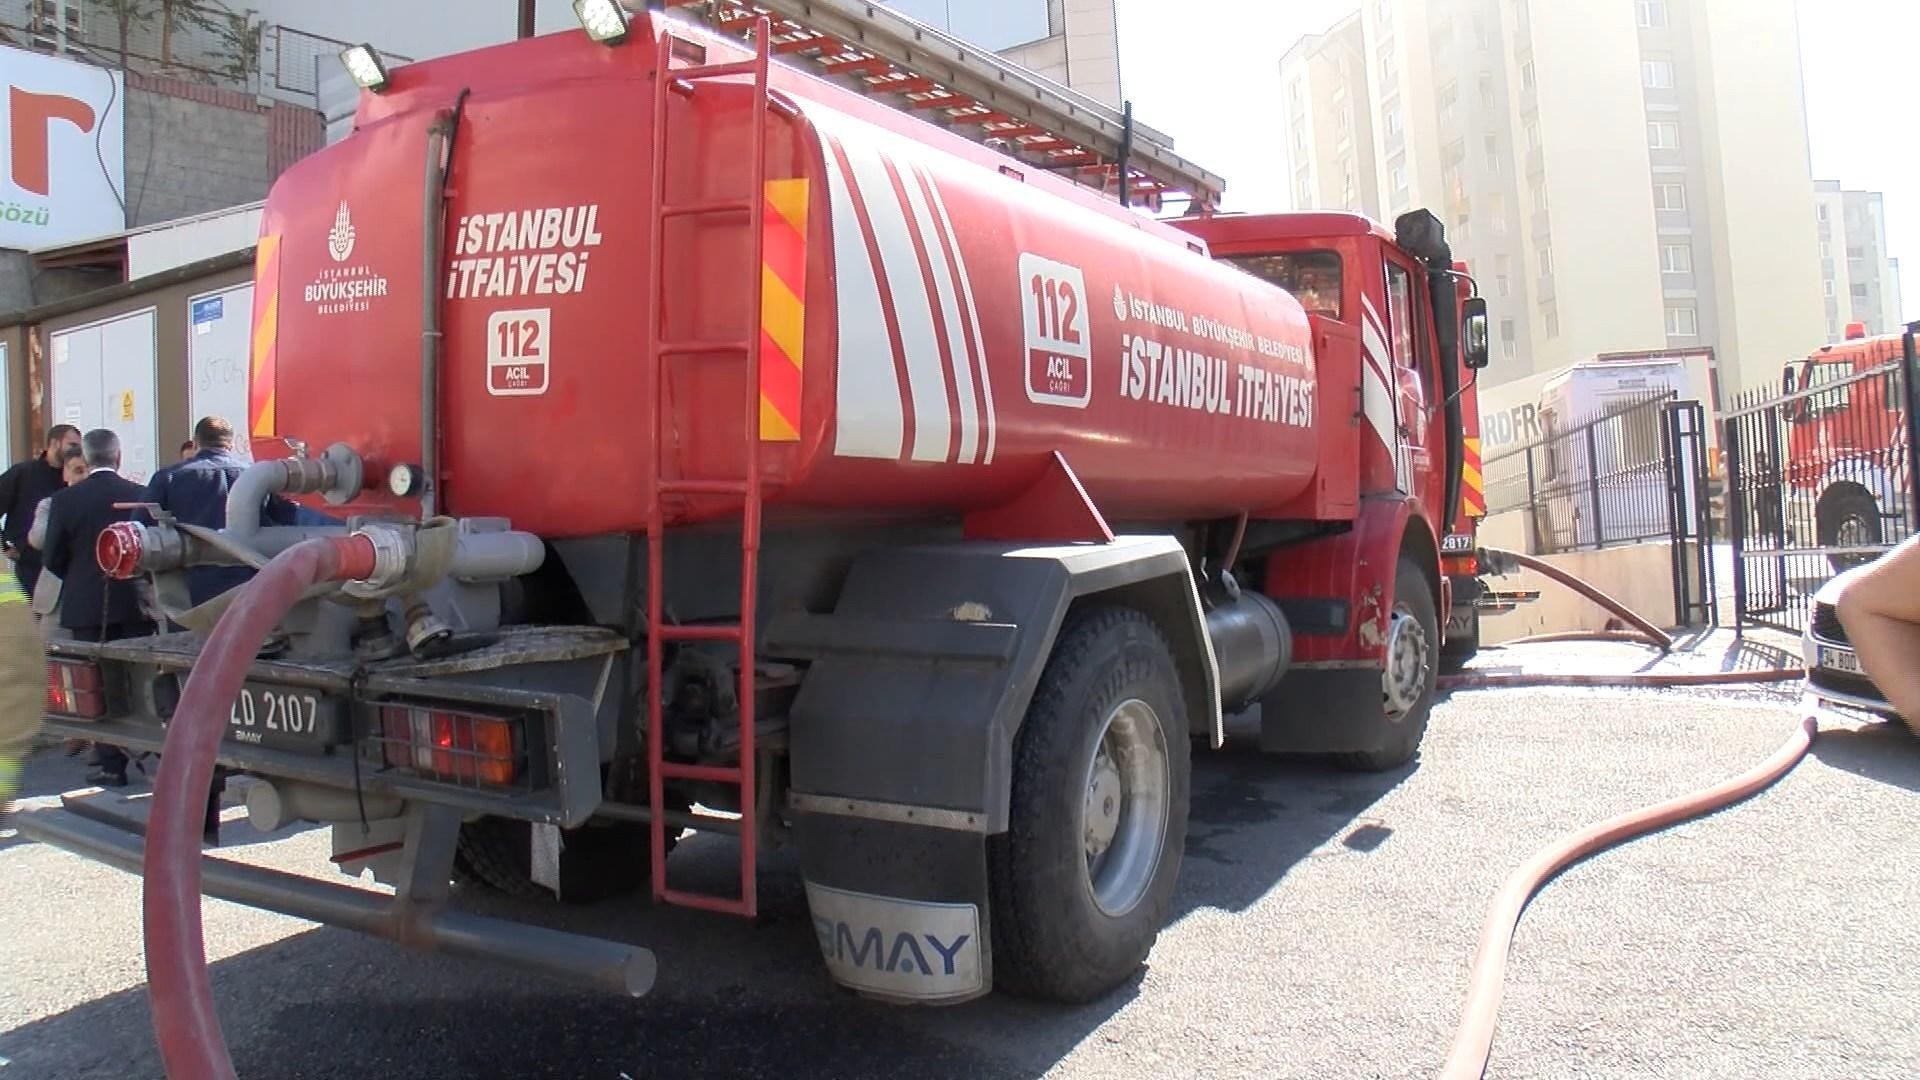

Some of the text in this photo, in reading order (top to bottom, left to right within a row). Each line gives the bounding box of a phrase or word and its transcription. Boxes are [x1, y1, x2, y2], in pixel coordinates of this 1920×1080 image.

[0, 202, 49, 226] özü
[304, 273, 388, 302] BÜYÜKŞEHİR
[1031, 274, 1081, 345] 112
[497, 319, 540, 358] 112
[264, 691, 317, 733] 2107
